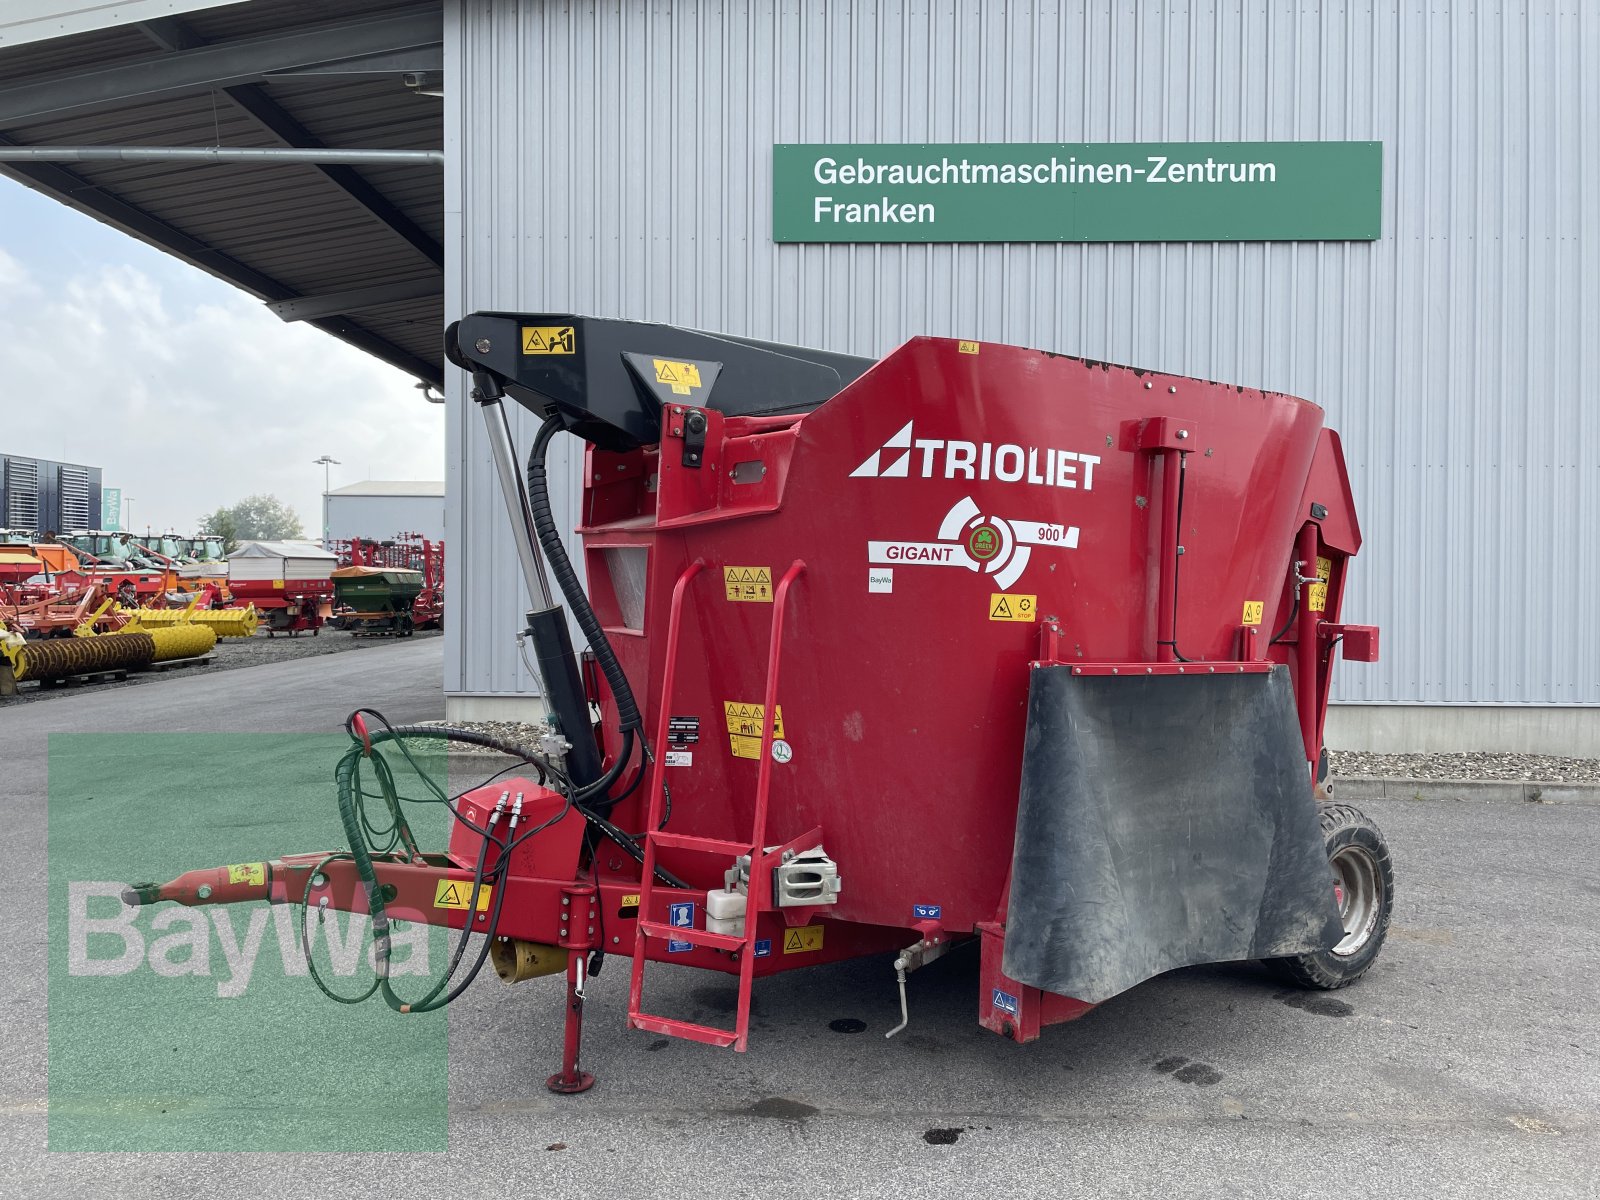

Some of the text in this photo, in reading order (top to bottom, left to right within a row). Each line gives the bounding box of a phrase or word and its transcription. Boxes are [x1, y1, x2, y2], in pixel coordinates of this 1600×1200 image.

[813, 156, 1277, 186] Gebrauchtmaschinen-Zentrum
[813, 196, 936, 223] Franken
[915, 438, 1101, 491] TRIOLIET
[107, 490, 118, 524] BayWa
[1038, 526, 1060, 542] 900
[886, 546, 953, 561] GIGANT
[870, 576, 892, 585] BayWa
